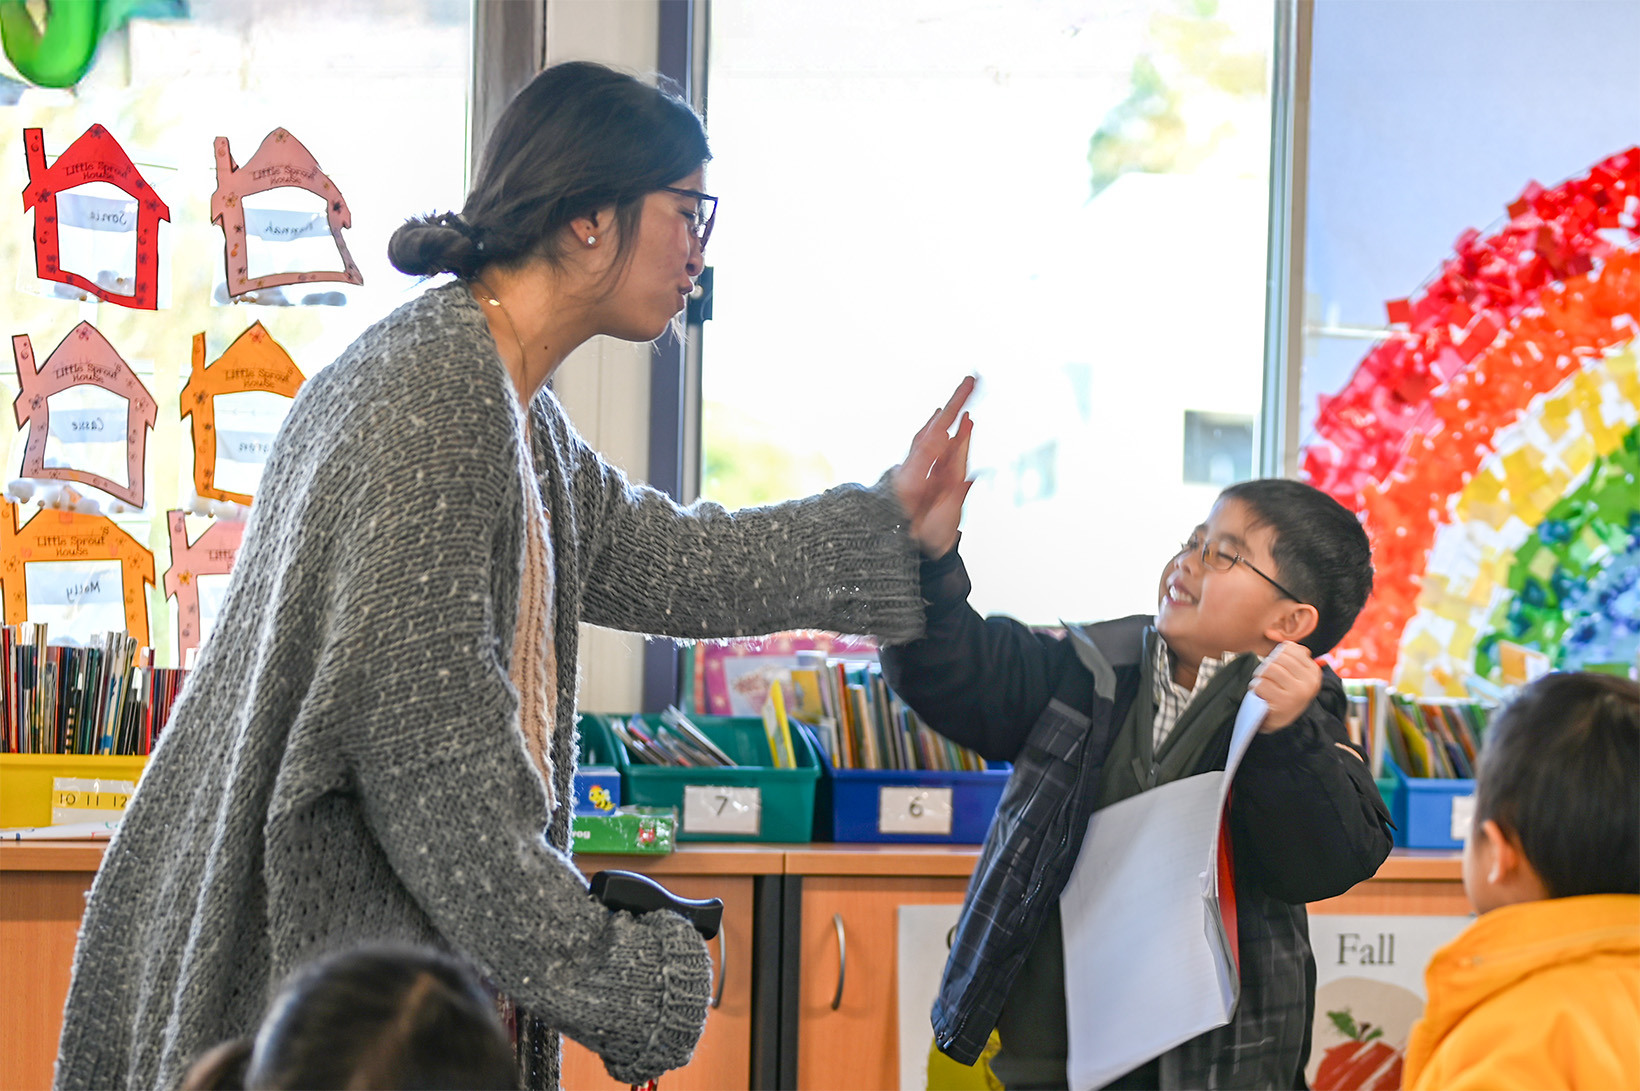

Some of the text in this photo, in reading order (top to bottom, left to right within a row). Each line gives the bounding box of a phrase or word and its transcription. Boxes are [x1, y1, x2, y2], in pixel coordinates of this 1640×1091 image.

[65, 161, 95, 177] Little
[252, 165, 281, 181] Little
[55, 363, 84, 379] Little
[224, 366, 255, 382] Little
[36, 534, 67, 548] Little
[59, 792, 128, 809] 10 11 12
[713, 794, 729, 817] 7
[908, 795, 925, 819] 6
[1336, 932, 1395, 966] Fall
